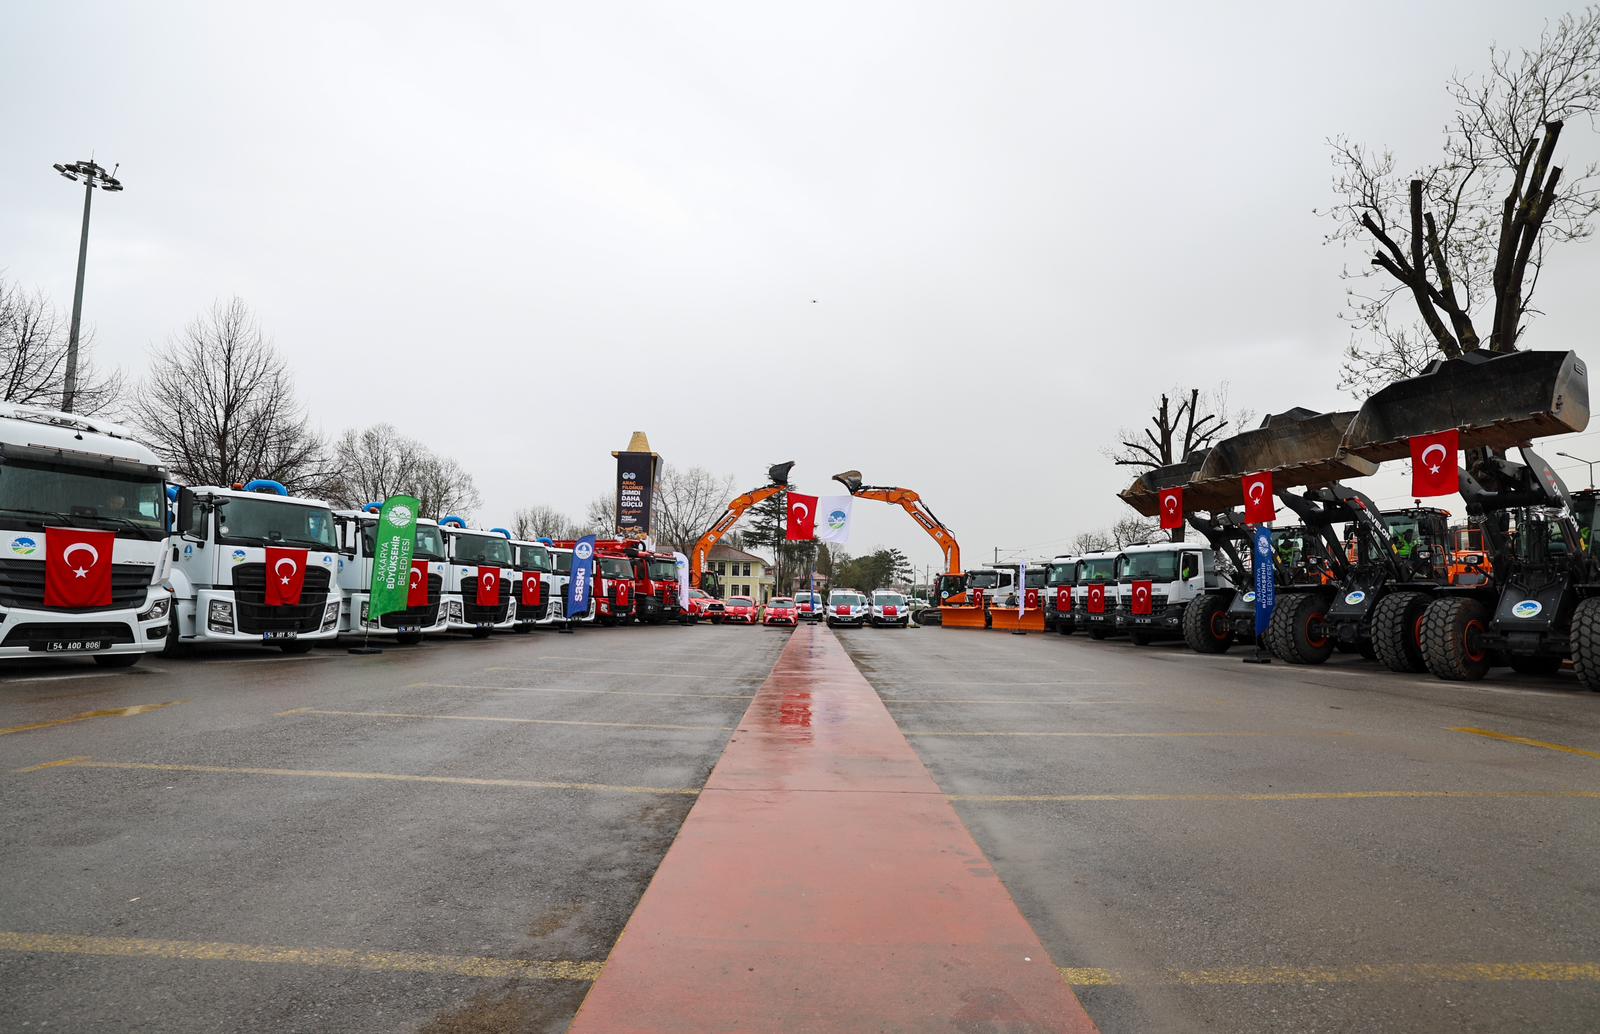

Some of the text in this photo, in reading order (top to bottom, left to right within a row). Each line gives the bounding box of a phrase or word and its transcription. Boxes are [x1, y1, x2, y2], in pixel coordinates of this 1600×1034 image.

[1363, 508, 1390, 541] DEVELON
[377, 542, 389, 582] SAKARYA
[386, 535, 400, 589] BÜYÜKŞEHİR
[398, 538, 410, 586] BELEDİYESİ
[53, 642, 63, 650] 54
